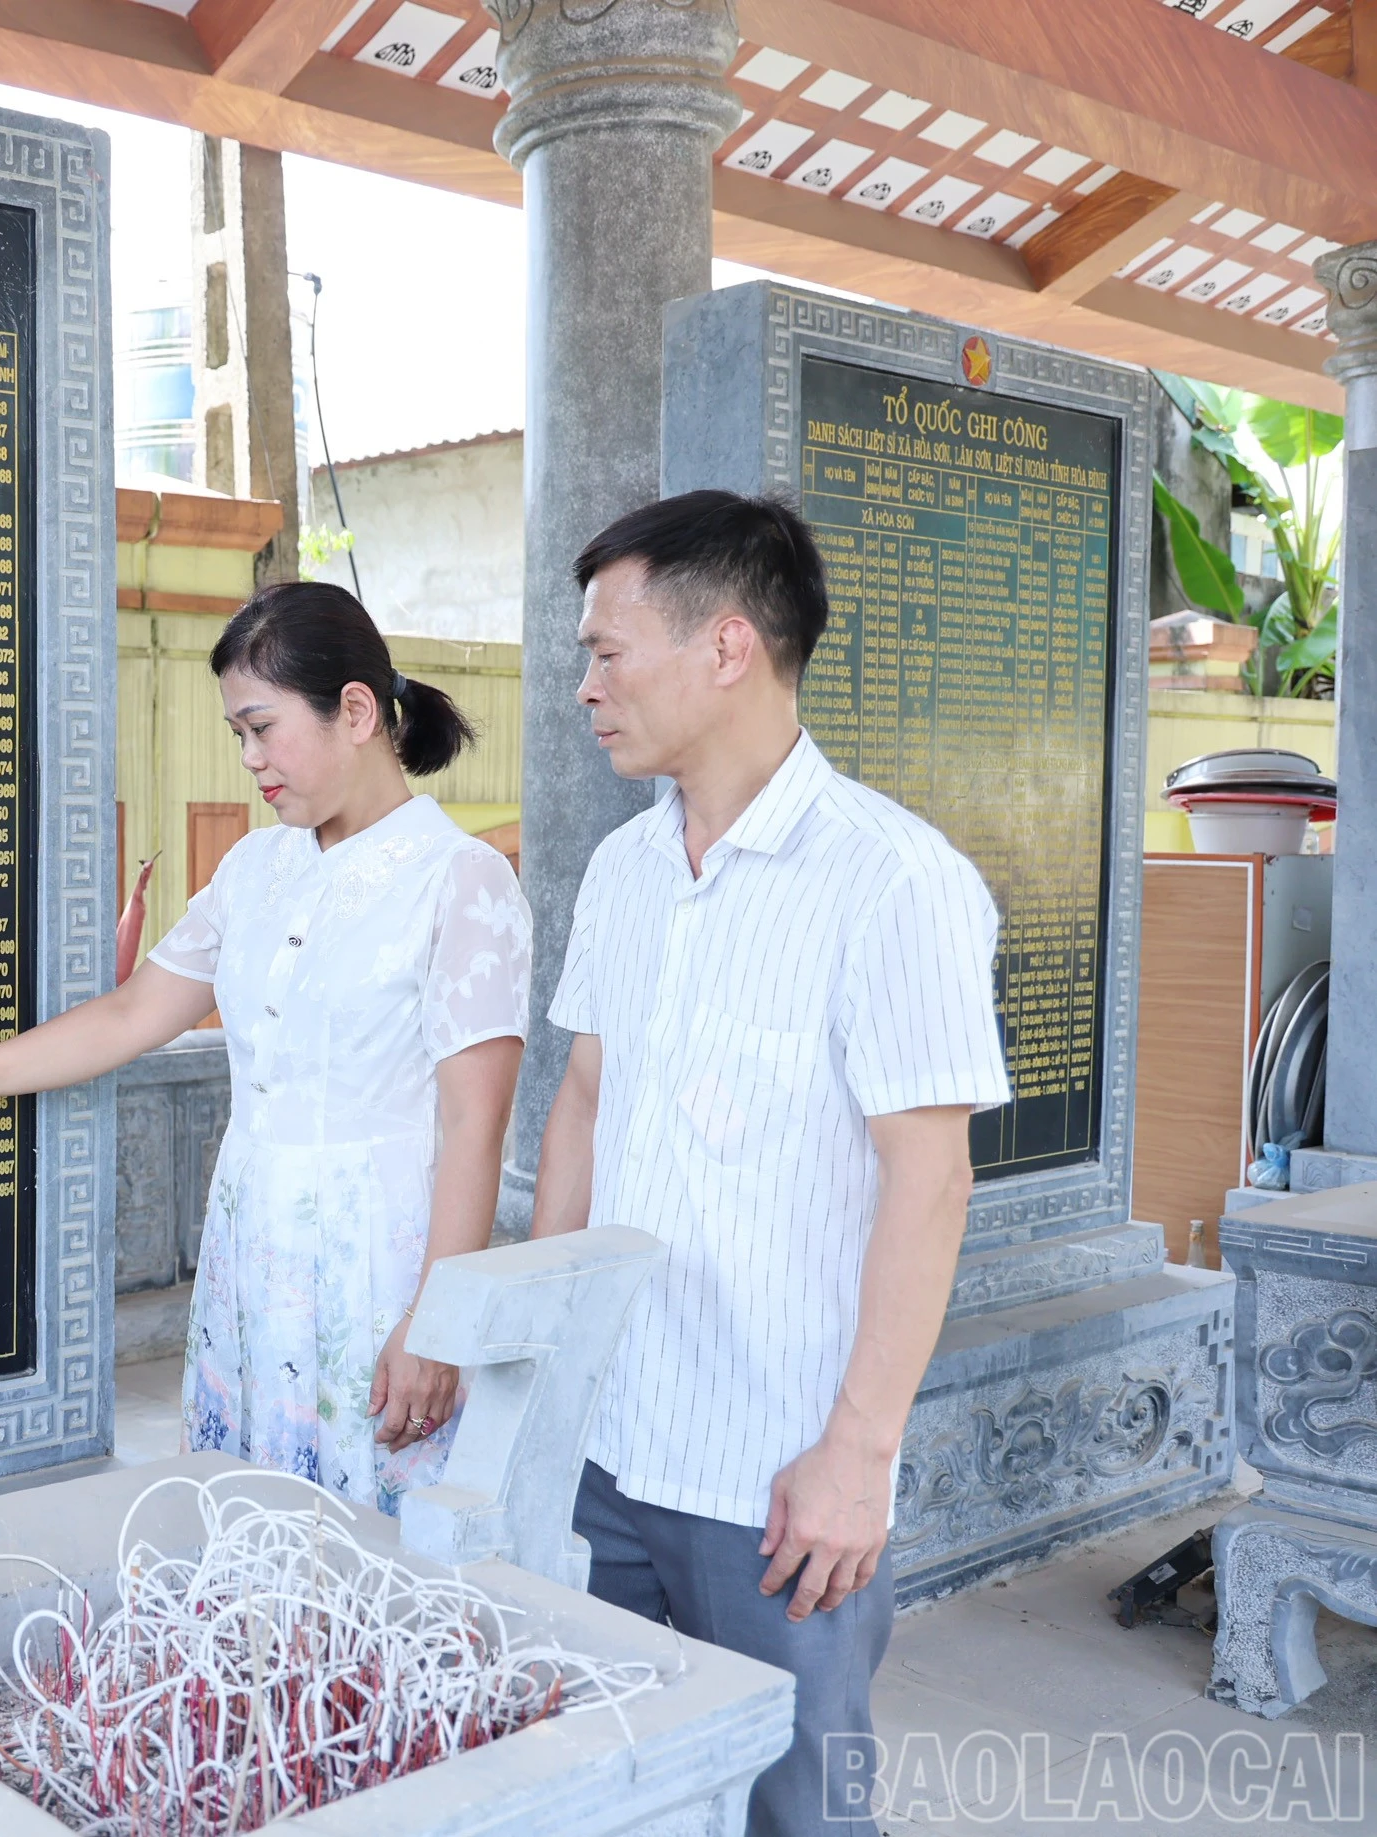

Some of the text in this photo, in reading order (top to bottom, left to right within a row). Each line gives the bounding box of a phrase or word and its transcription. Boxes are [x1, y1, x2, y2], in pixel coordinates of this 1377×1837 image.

[883, 386, 1048, 450] TỔ QUỐC GHI CÔNG
[862, 509, 915, 529] XÃ HÒA SƠN
